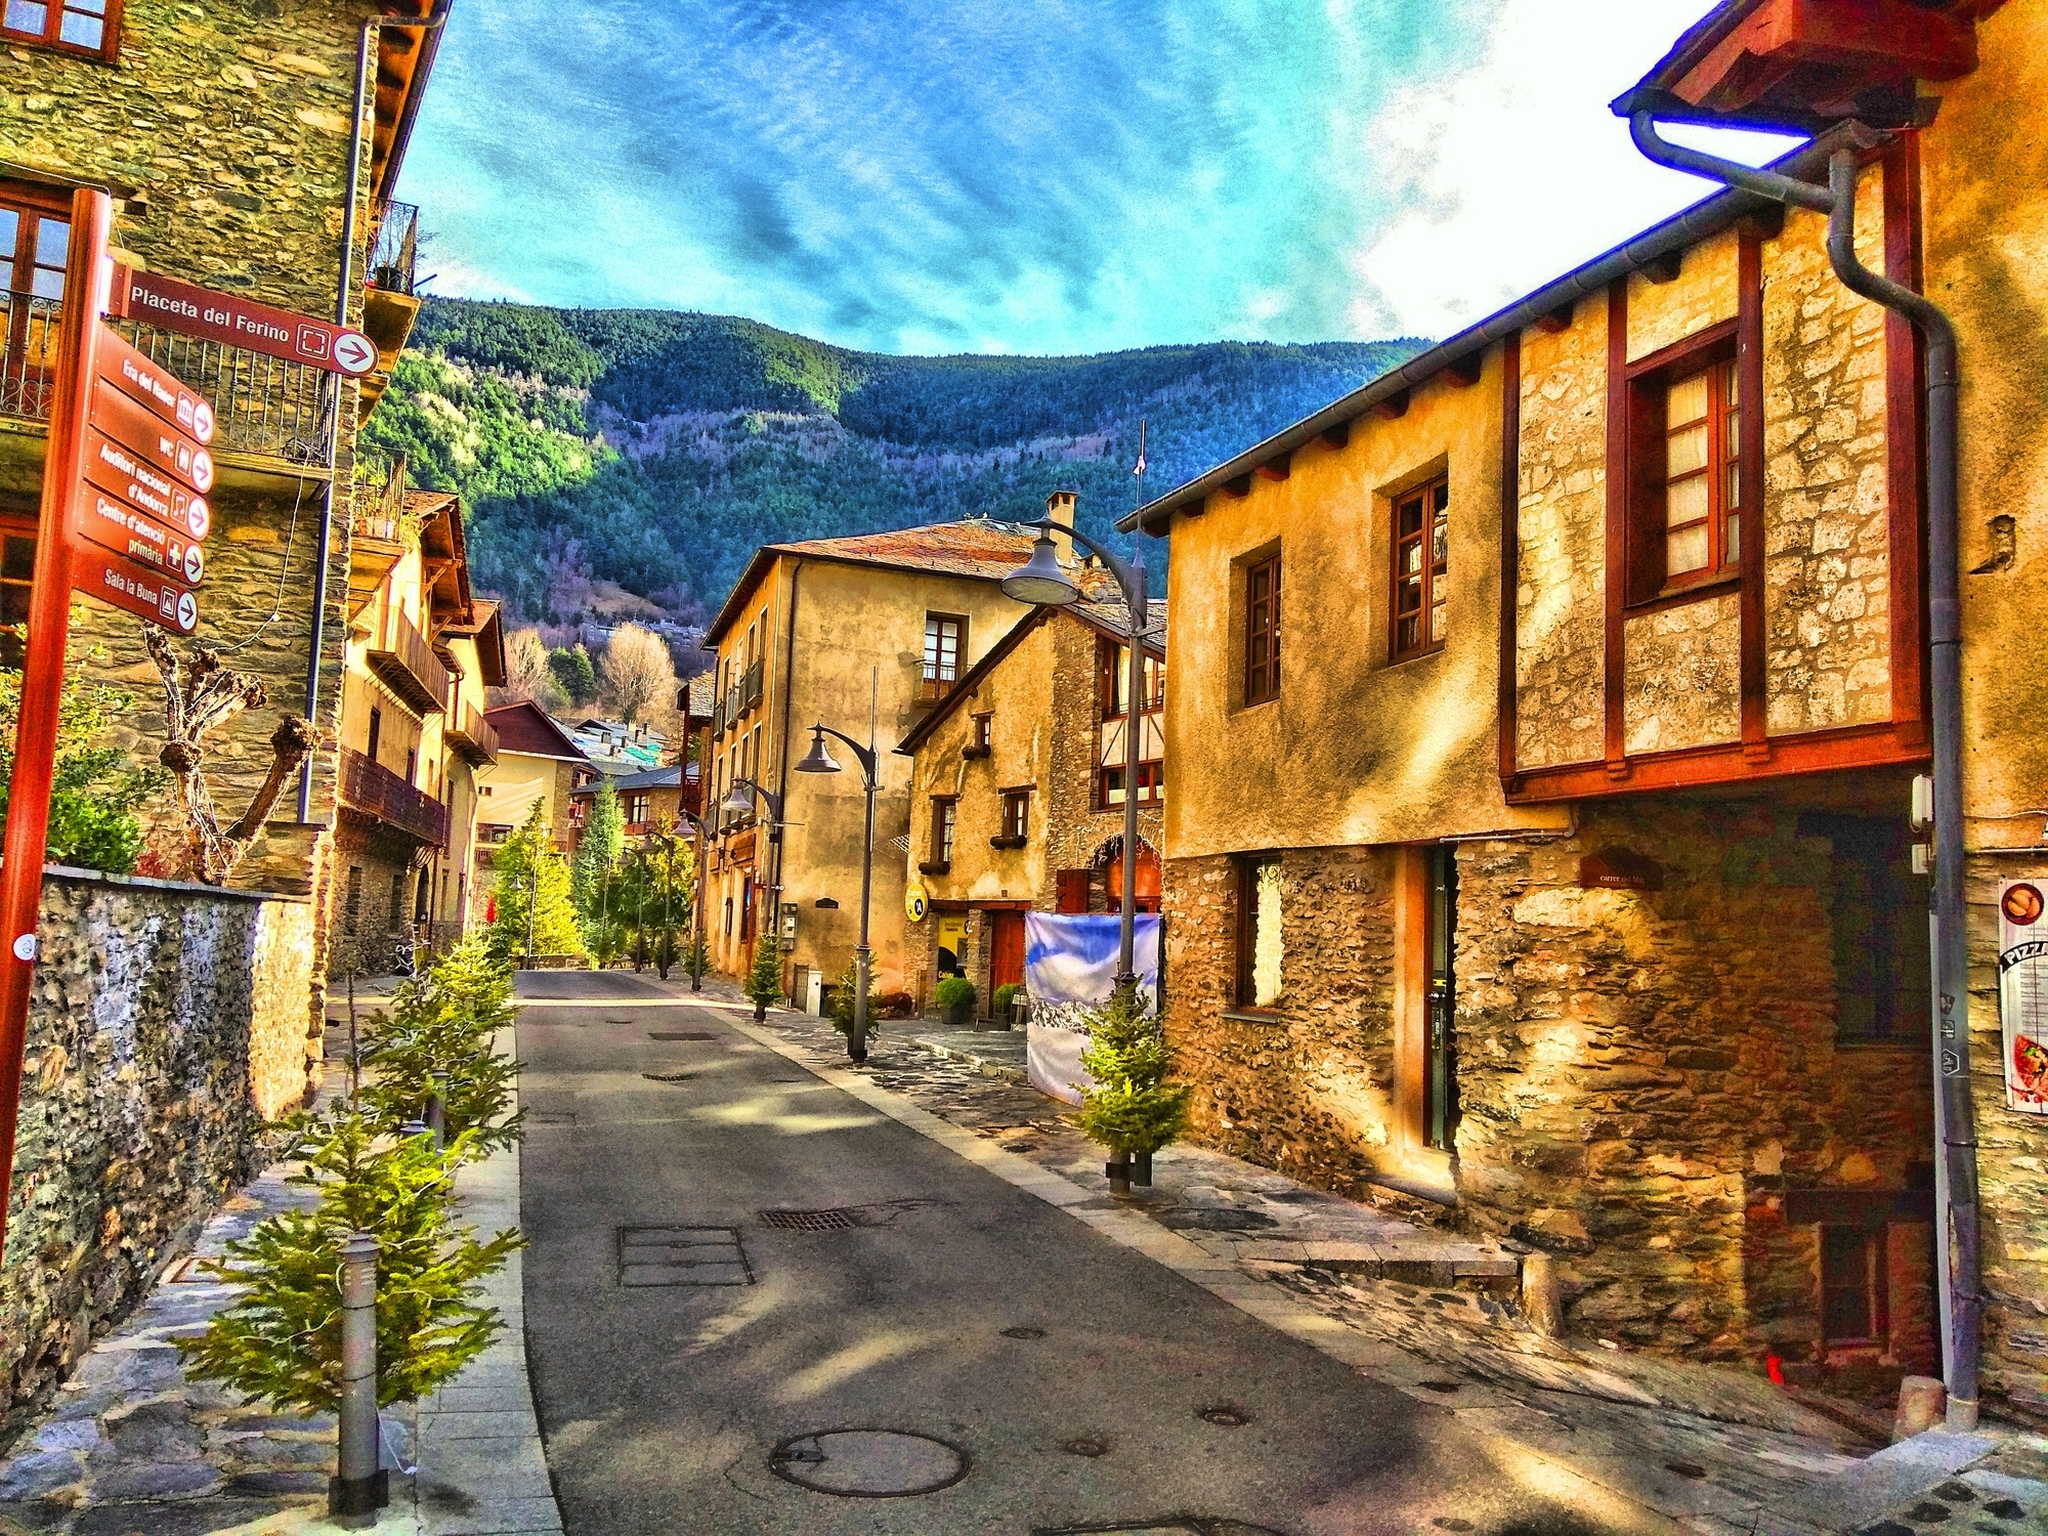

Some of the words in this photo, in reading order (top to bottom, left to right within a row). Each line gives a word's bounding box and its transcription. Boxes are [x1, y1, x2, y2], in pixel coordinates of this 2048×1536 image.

[131, 286, 198, 318] Placeta
[204, 307, 230, 327] del
[236, 314, 289, 342] Ferino
[123, 358, 138, 383] Era
[138, 371, 153, 392] del
[159, 435, 174, 458] WC
[100, 443, 136, 477] Auditori
[135, 467, 171, 497] nacional
[127, 483, 169, 518] d'Andorra
[97, 497, 127, 526] Centre
[127, 514, 165, 545] d'atenció
[128, 539, 163, 566] primària
[104, 568, 125, 591] Sala
[126, 577, 135, 596] la
[136, 582, 158, 605] Buna
